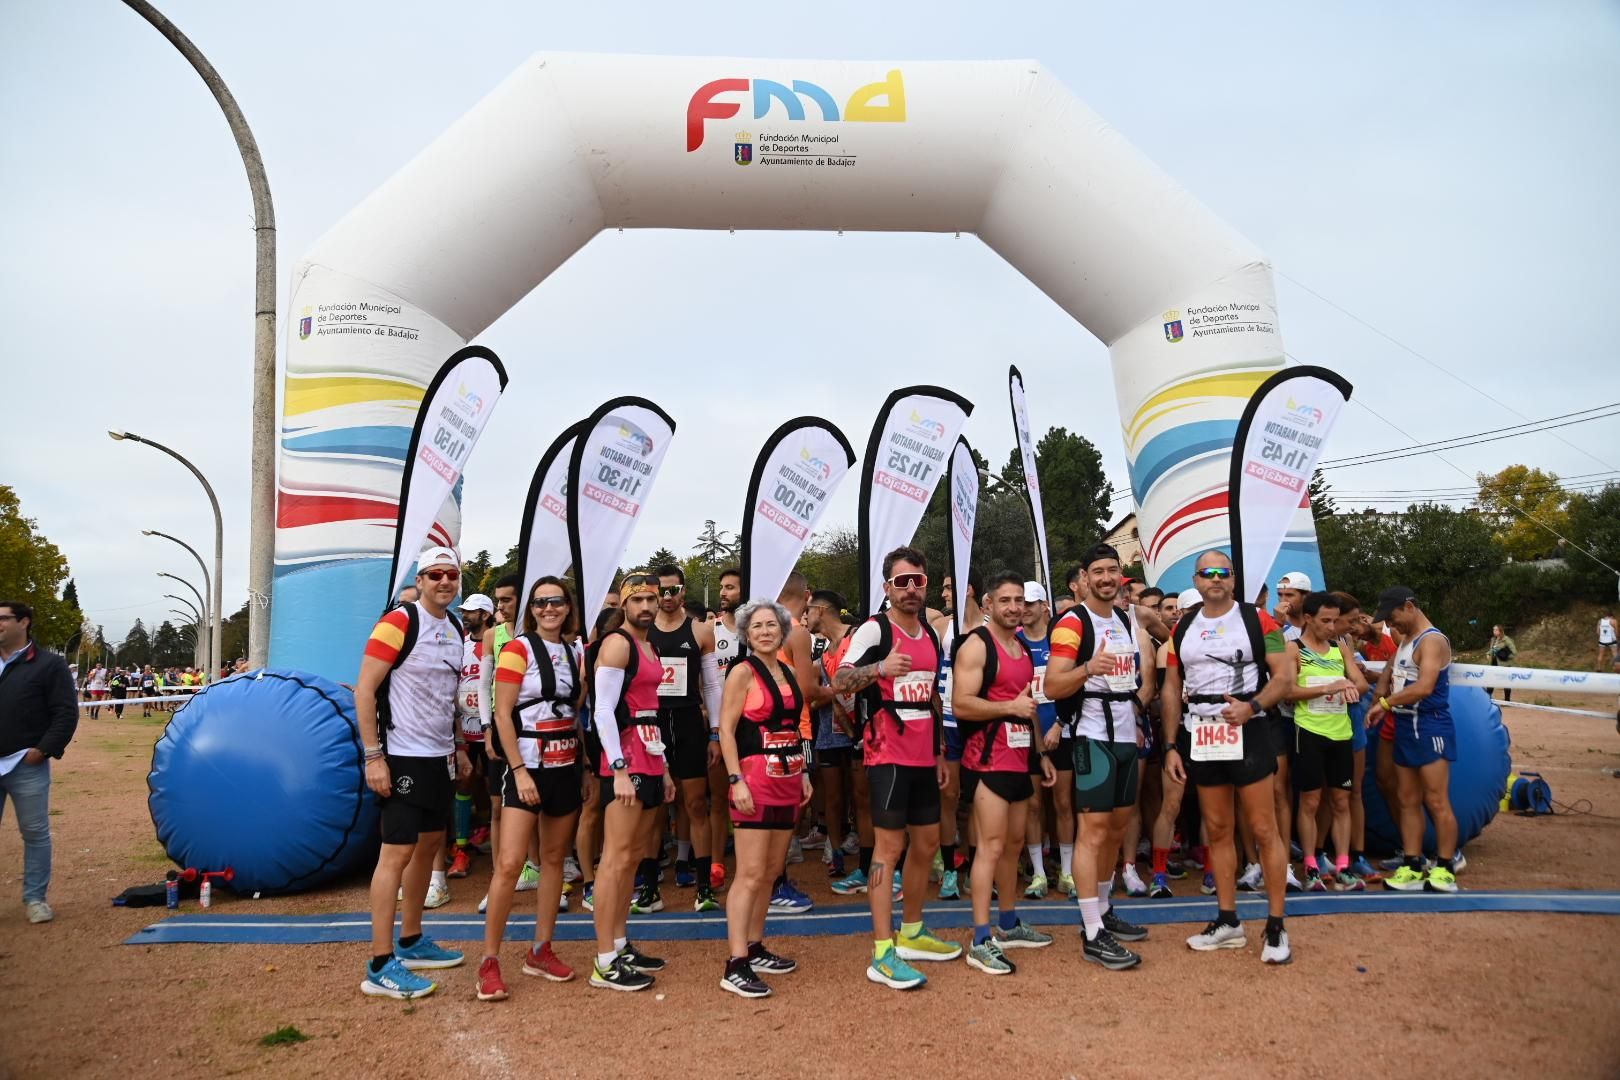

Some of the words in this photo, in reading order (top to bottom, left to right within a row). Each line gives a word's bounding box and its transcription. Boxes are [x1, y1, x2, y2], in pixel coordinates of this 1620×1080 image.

[759, 133, 799, 143] Fundación
[801, 134, 839, 145] Municipal
[759, 143, 770, 152] de
[772, 143, 809, 154] Deportes
[759, 156, 814, 167] Ayuntamiento
[815, 157, 825, 166] de
[827, 157, 856, 168] Badajoz
[318, 302, 357, 313] Fundación
[359, 302, 402, 315] Municipal
[1187, 304, 1228, 316] Fundación
[317, 314, 327, 323] de
[329, 313, 368, 323] Deportes
[1189, 316, 1201, 325] de
[1202, 314, 1240, 324] Deportes
[317, 326, 372, 337] Ayuntamiento
[374, 327, 385, 336] de
[387, 328, 420, 341] Badajoz
[1192, 325, 1246, 338] Ayuntamiento
[1246, 324, 1255, 332] de
[1195, 724, 1239, 747] 1H45
